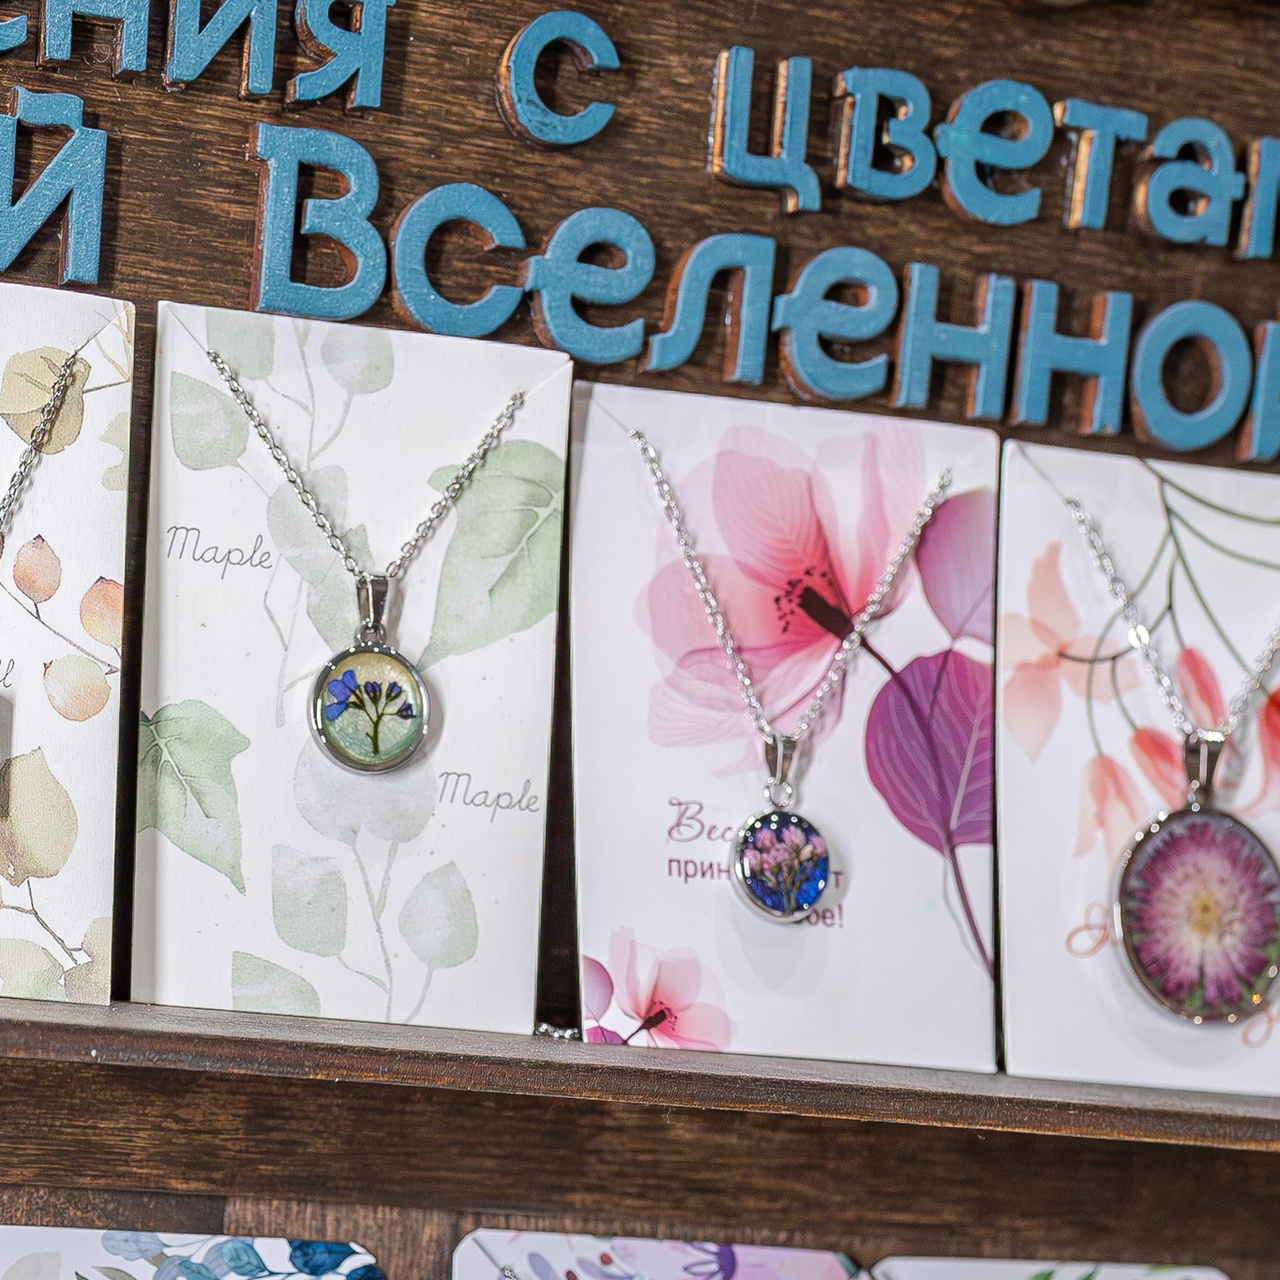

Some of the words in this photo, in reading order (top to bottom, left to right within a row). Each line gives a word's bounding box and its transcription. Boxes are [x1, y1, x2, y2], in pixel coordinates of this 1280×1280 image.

[495, 10, 622, 146] с
[710, 44, 1280, 259] цвета
[254, 120, 1280, 461] Вселенно
[167, 525, 273, 579] Maple
[438, 771, 540, 823] Maple
